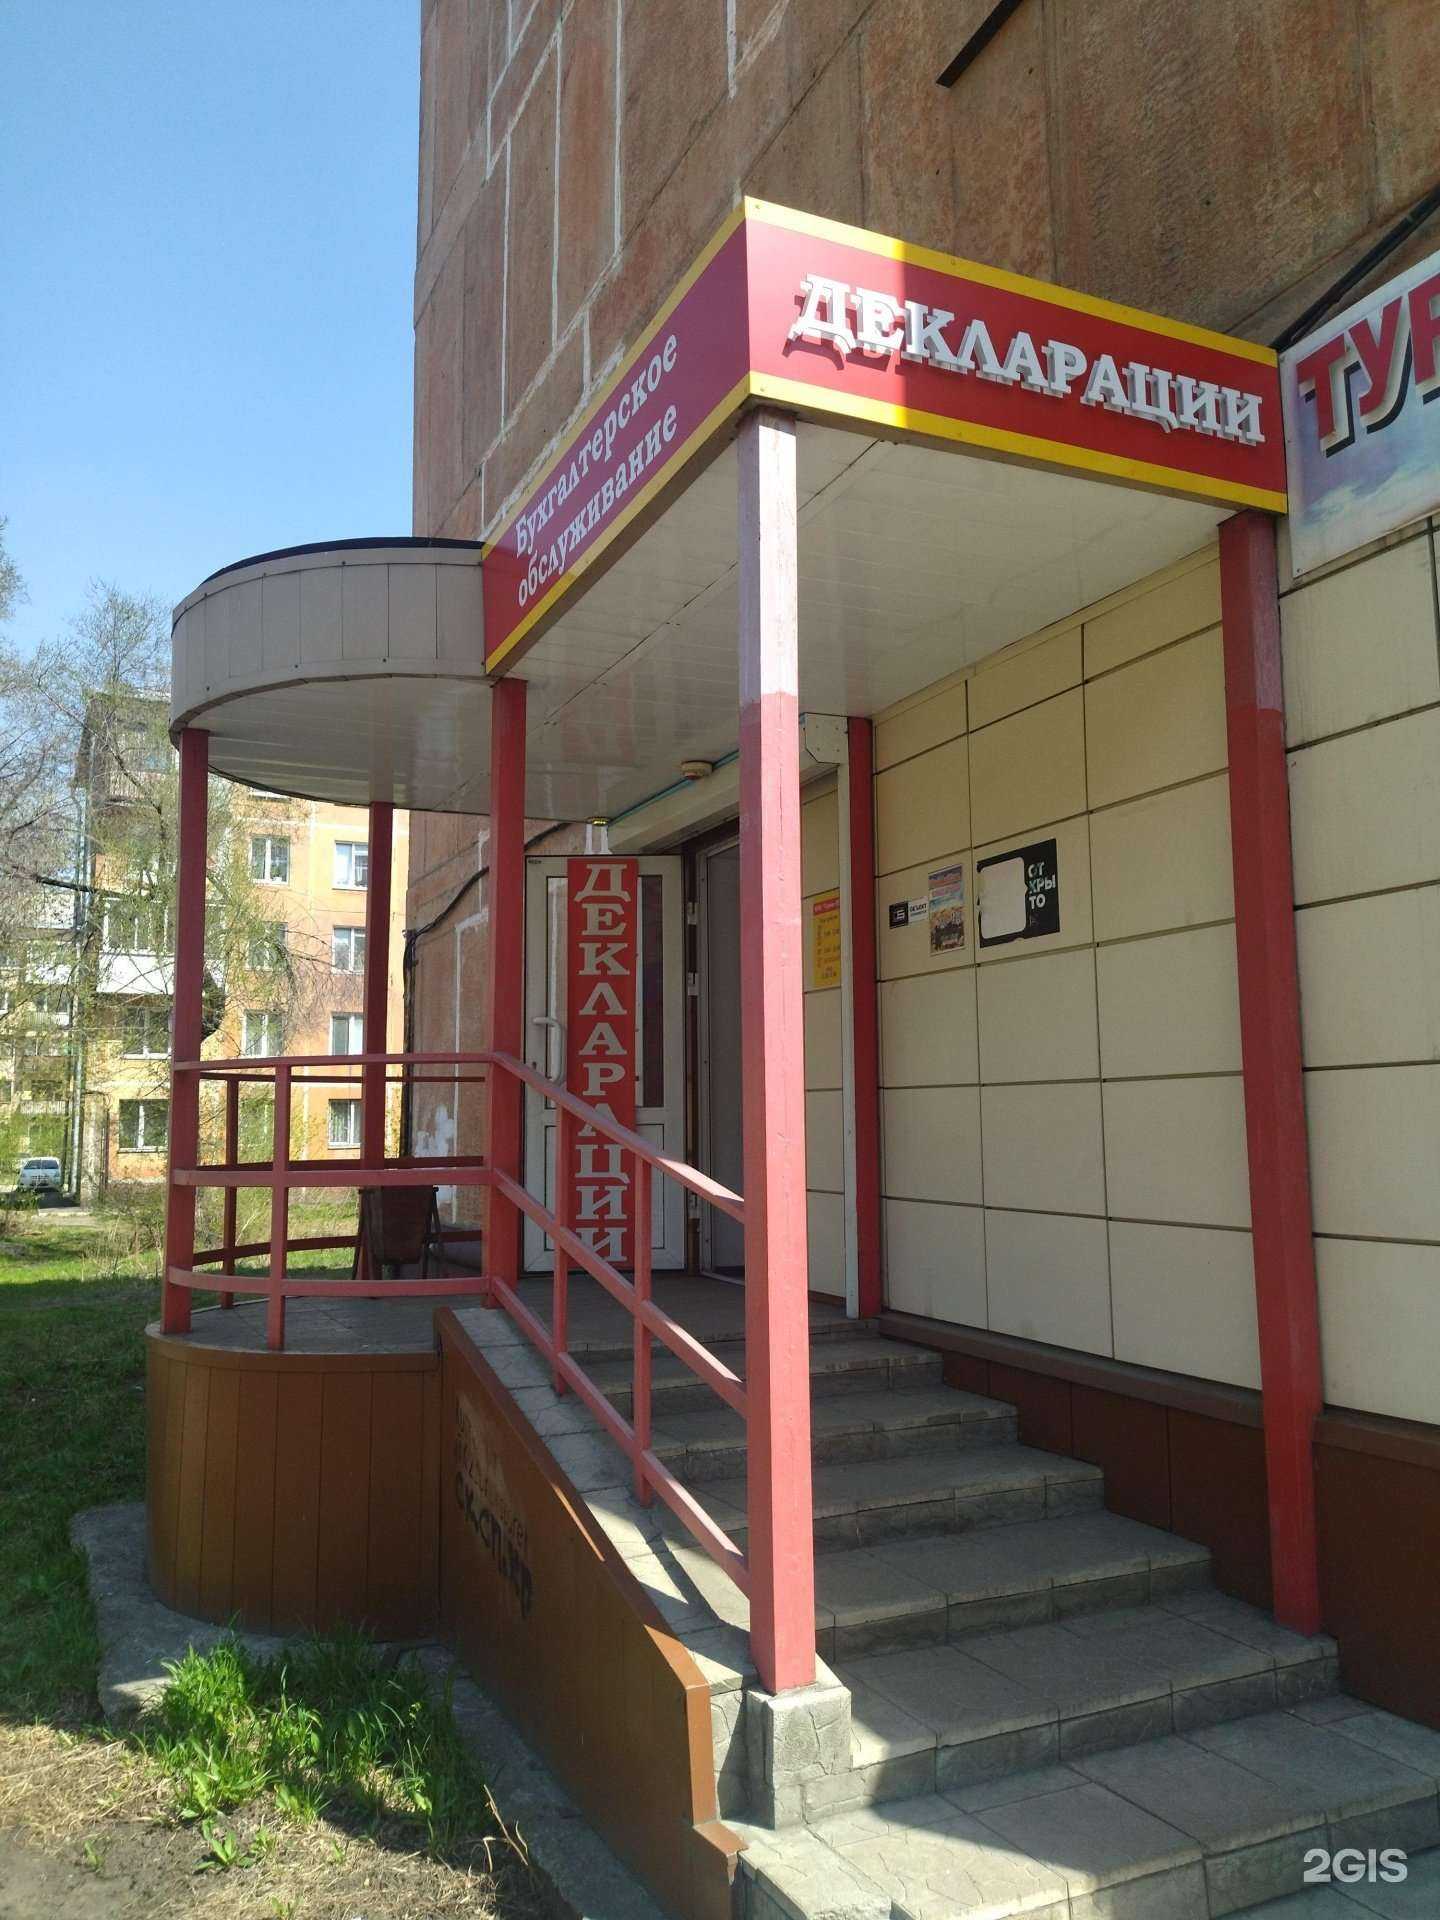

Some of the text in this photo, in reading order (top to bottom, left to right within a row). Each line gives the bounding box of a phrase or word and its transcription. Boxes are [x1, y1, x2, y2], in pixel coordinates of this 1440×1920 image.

[514, 334, 677, 559] Бухгалтерское
[787, 273, 1266, 446] ДЕКЛАРАЦИИ
[517, 404, 678, 608] обслуживание
